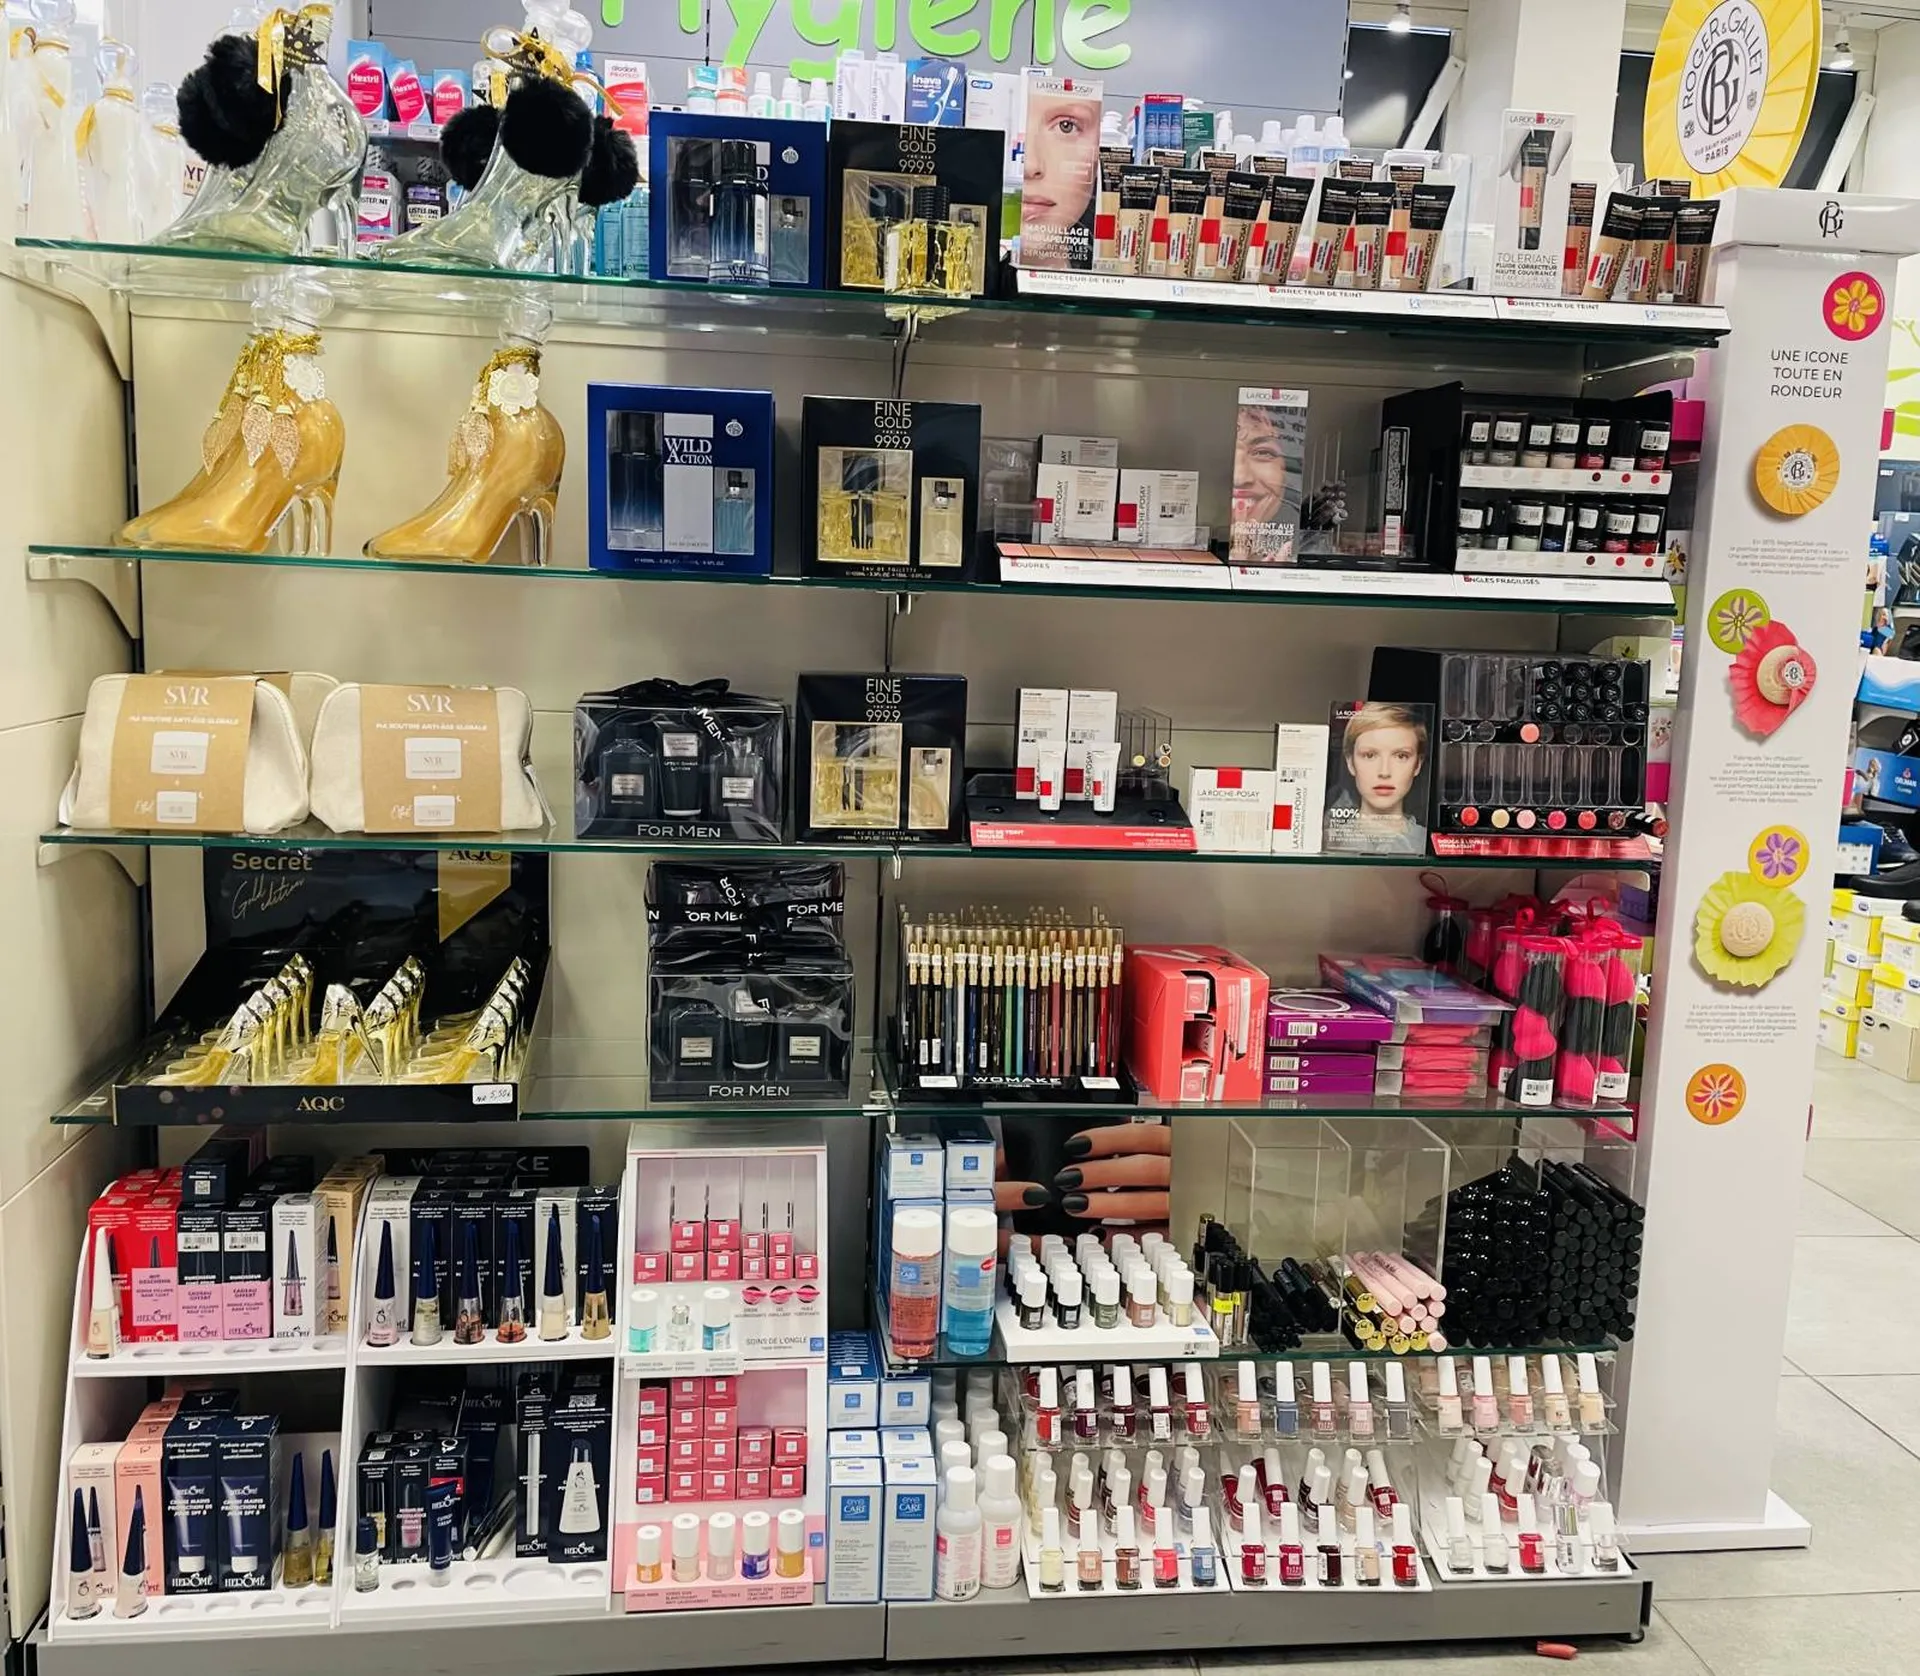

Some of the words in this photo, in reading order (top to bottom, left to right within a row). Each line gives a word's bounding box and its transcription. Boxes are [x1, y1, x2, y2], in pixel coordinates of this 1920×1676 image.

[350, 73, 380, 84] Hextril
[912, 74, 942, 85] Inava
[393, 81, 418, 93] Hextril
[435, 91, 460, 99] Hextril
[900, 126, 936, 141] FINE
[899, 140, 936, 154] GOLD
[1705, 145, 1729, 163] PARIS
[899, 159, 935, 174] 999.9
[1770, 350, 1801, 362] UNE
[1804, 351, 1850, 364] ICONE
[1773, 367, 1819, 381] TOUTE
[1823, 370, 1843, 382] EN
[1770, 384, 1843, 399] RONDEUR
[874, 401, 912, 417] FINE
[874, 416, 912, 429] GOLD
[663, 437, 712, 454] WILD
[874, 434, 911, 449] 999.9
[666, 449, 713, 465] ACTION
[1279, 523, 1295, 531] AUX
[866, 678, 901, 693] FINE
[163, 685, 210, 706] SVR
[865, 692, 902, 704] GOLD
[407, 693, 455, 714] SVR
[141, 716, 173, 724] ROUTINE
[207, 718, 239, 726] GLOBALE
[865, 709, 901, 722] 999.9
[1330, 808, 1360, 819] 100%
[637, 824, 674, 838] FOR
[679, 824, 721, 838] MEN
[231, 852, 313, 871] Secret
[448, 848, 504, 862] AQC
[718, 876, 742, 907] FOR
[787, 904, 818, 914] FOR
[972, 1075, 1062, 1085] WOMAKE
[708, 1084, 744, 1097] FOR
[749, 1084, 790, 1097] MEN
[296, 1095, 345, 1112] AQC
[768, 1337, 778, 1345] DE
[843, 1505, 866, 1513] CARE
[899, 1503, 923, 1511] CARE
